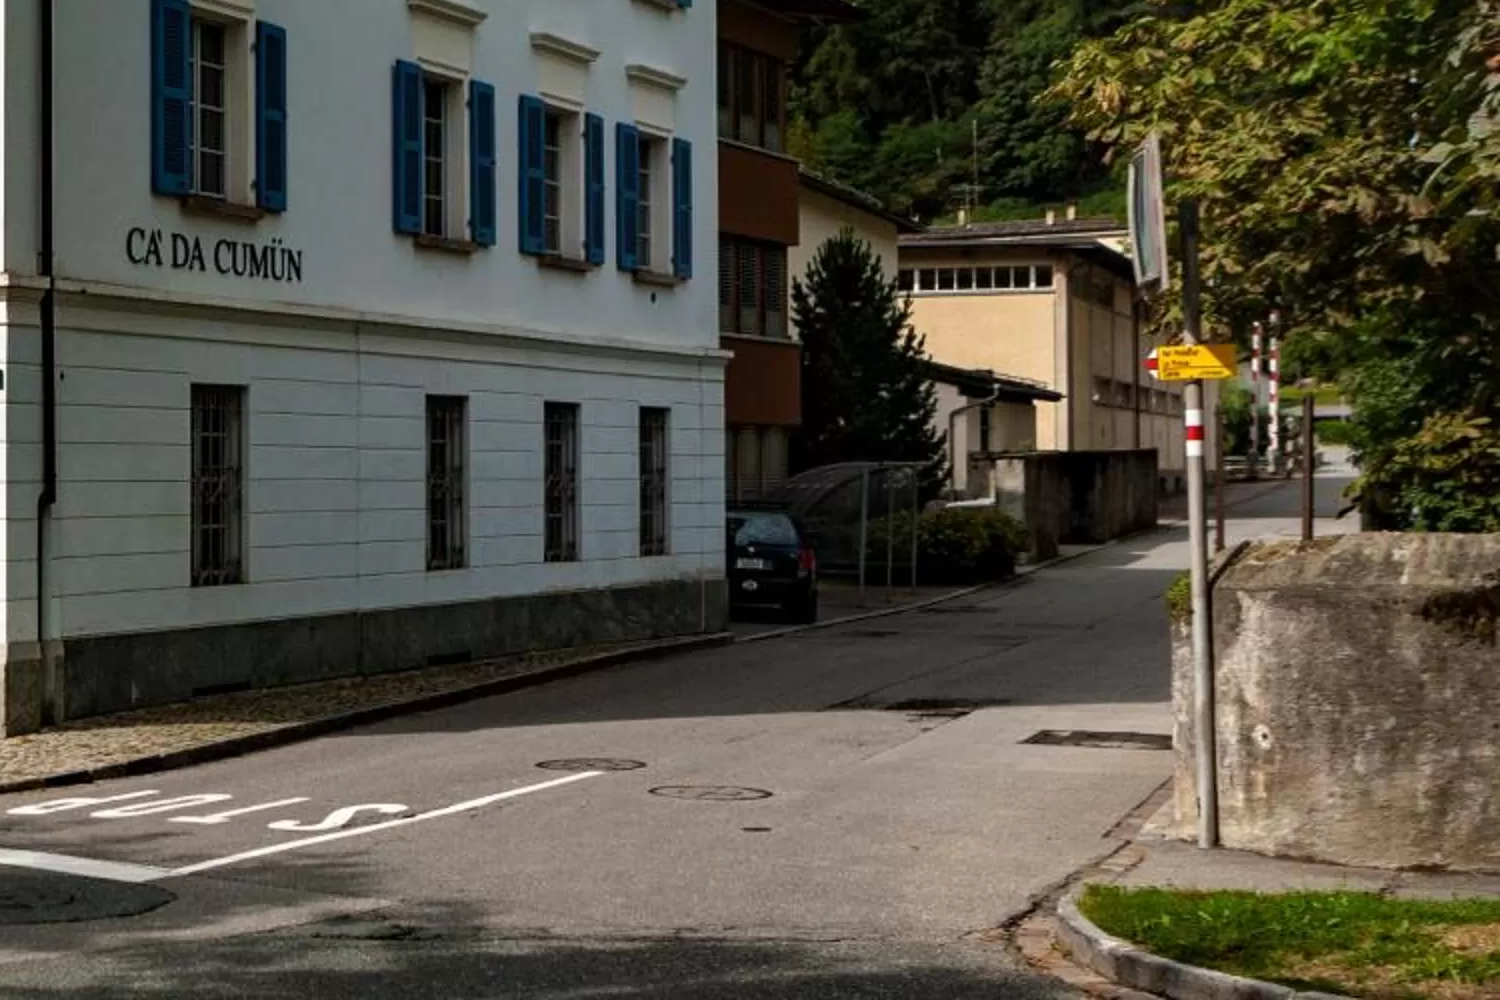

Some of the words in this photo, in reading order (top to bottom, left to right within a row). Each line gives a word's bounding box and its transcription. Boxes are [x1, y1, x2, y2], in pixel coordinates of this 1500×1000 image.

[171, 232, 206, 272] DA
[213, 237, 302, 282] CUMÜN
[5, 789, 409, 831] STOP
